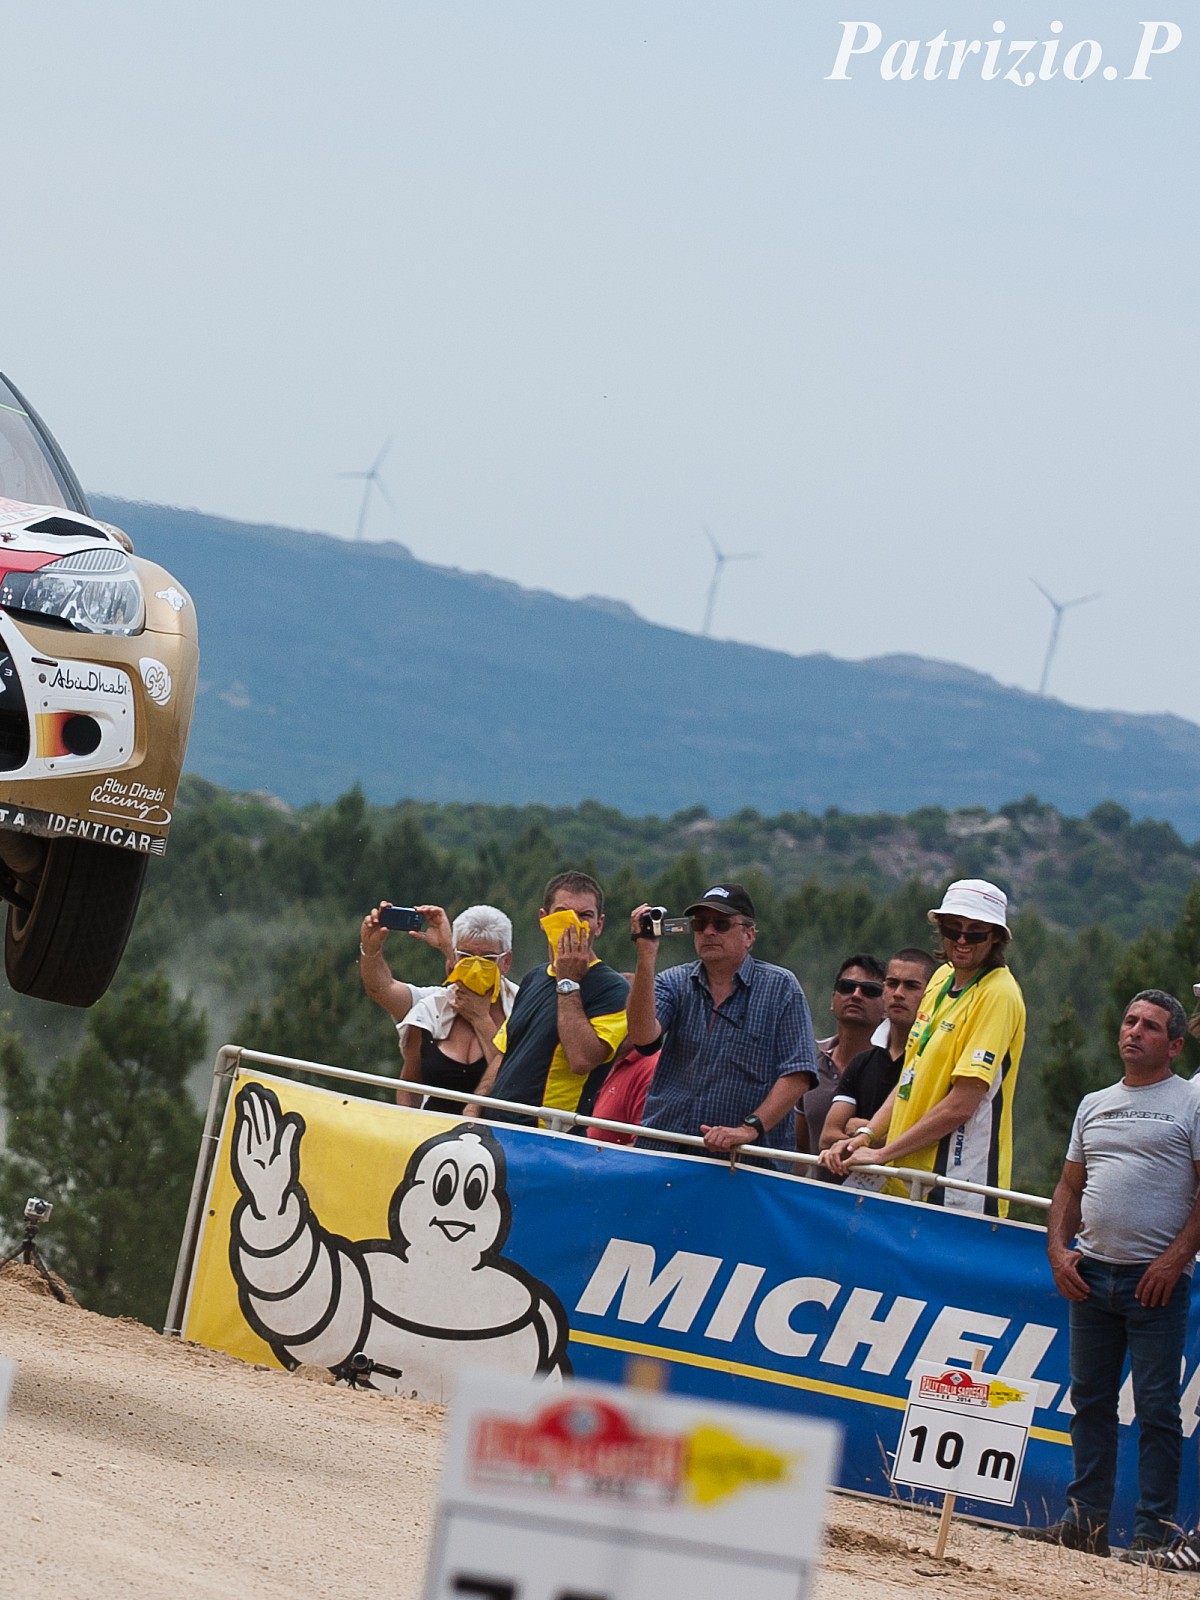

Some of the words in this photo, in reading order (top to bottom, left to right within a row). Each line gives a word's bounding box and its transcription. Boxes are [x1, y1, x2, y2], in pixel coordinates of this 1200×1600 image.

[90, 786, 160, 819] Racing
[102, 777, 127, 796] Abu
[129, 782, 167, 801] Dhabi
[47, 813, 151, 852] IDENTICAR
[909, 1425, 964, 1470] 10
[977, 1448, 1016, 1482] m
